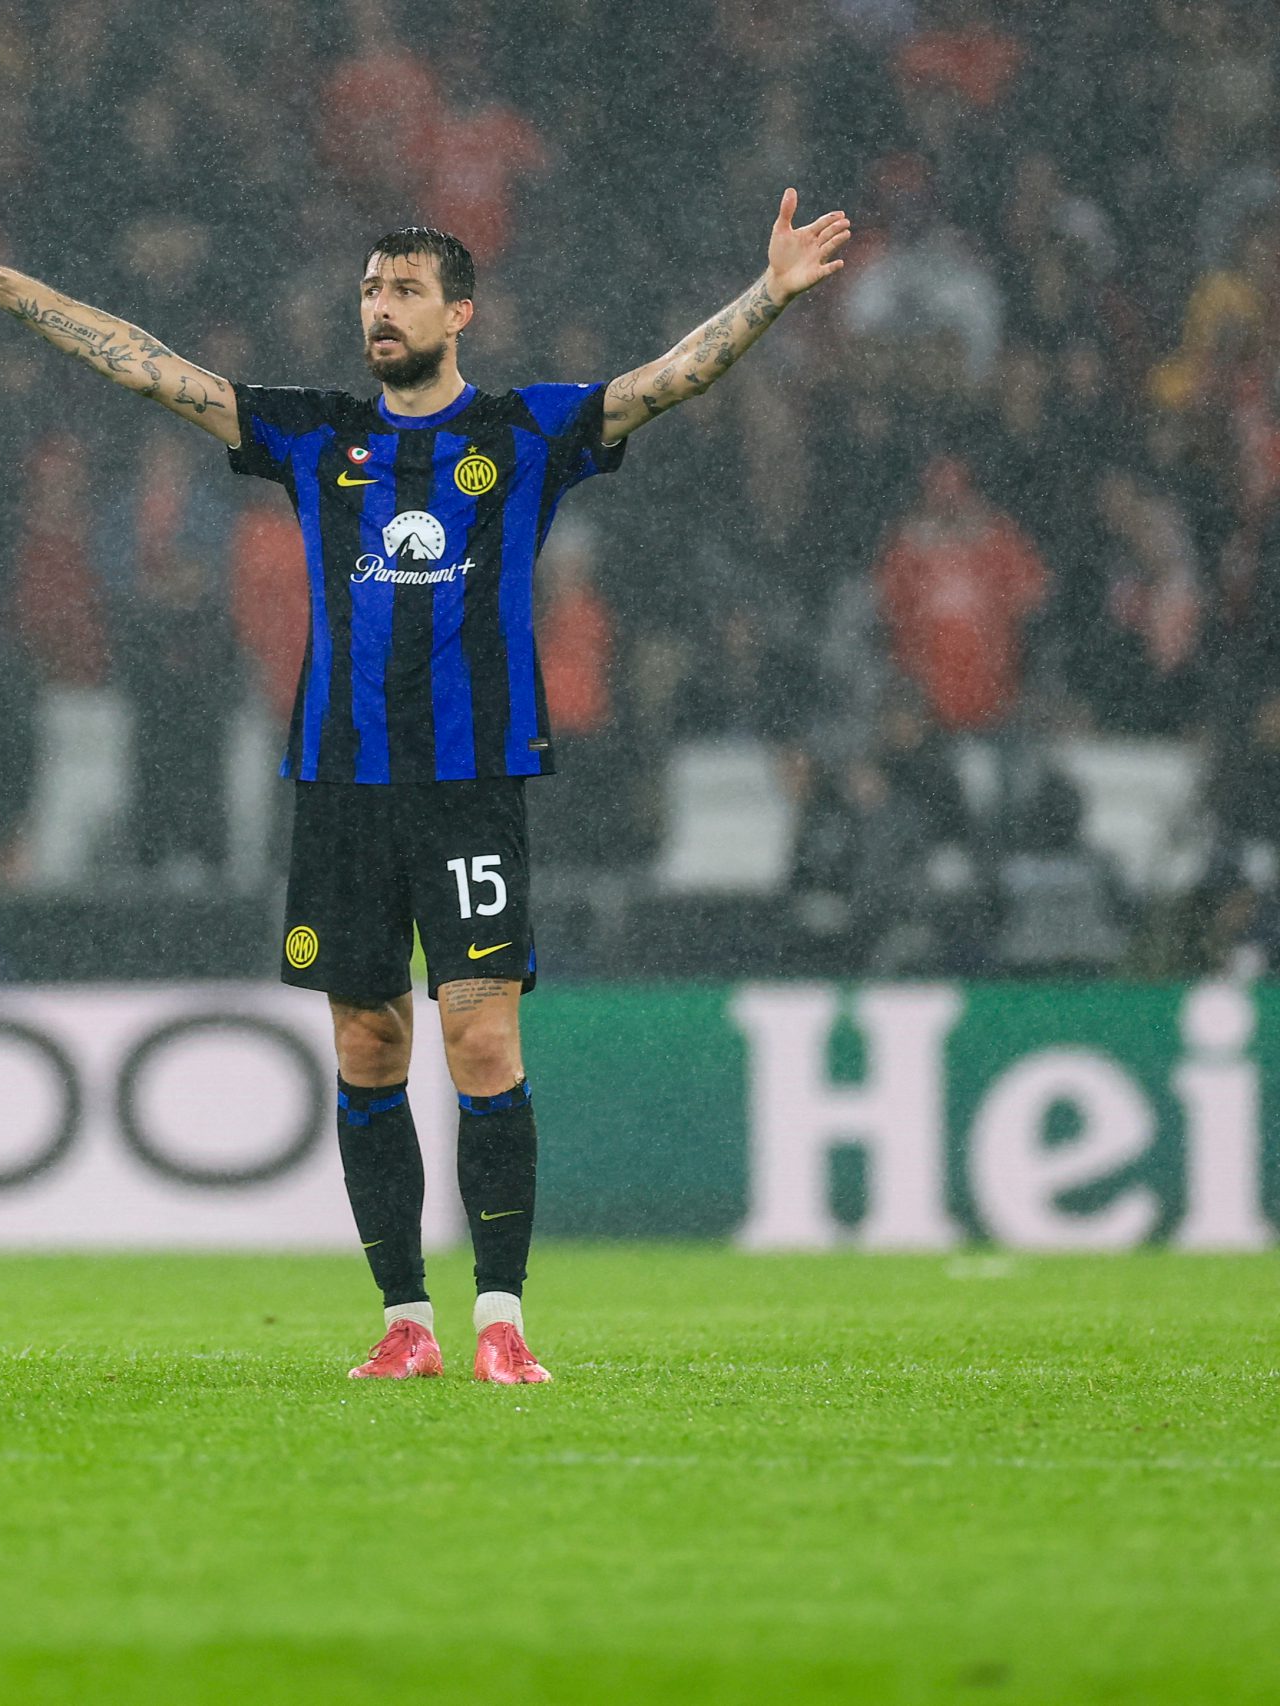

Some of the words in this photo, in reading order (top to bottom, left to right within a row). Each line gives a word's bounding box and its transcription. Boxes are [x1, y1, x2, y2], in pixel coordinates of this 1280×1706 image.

[350, 553, 476, 585] Paramount+
[447, 854, 507, 919] 15
[726, 979, 1273, 1250] Hei
